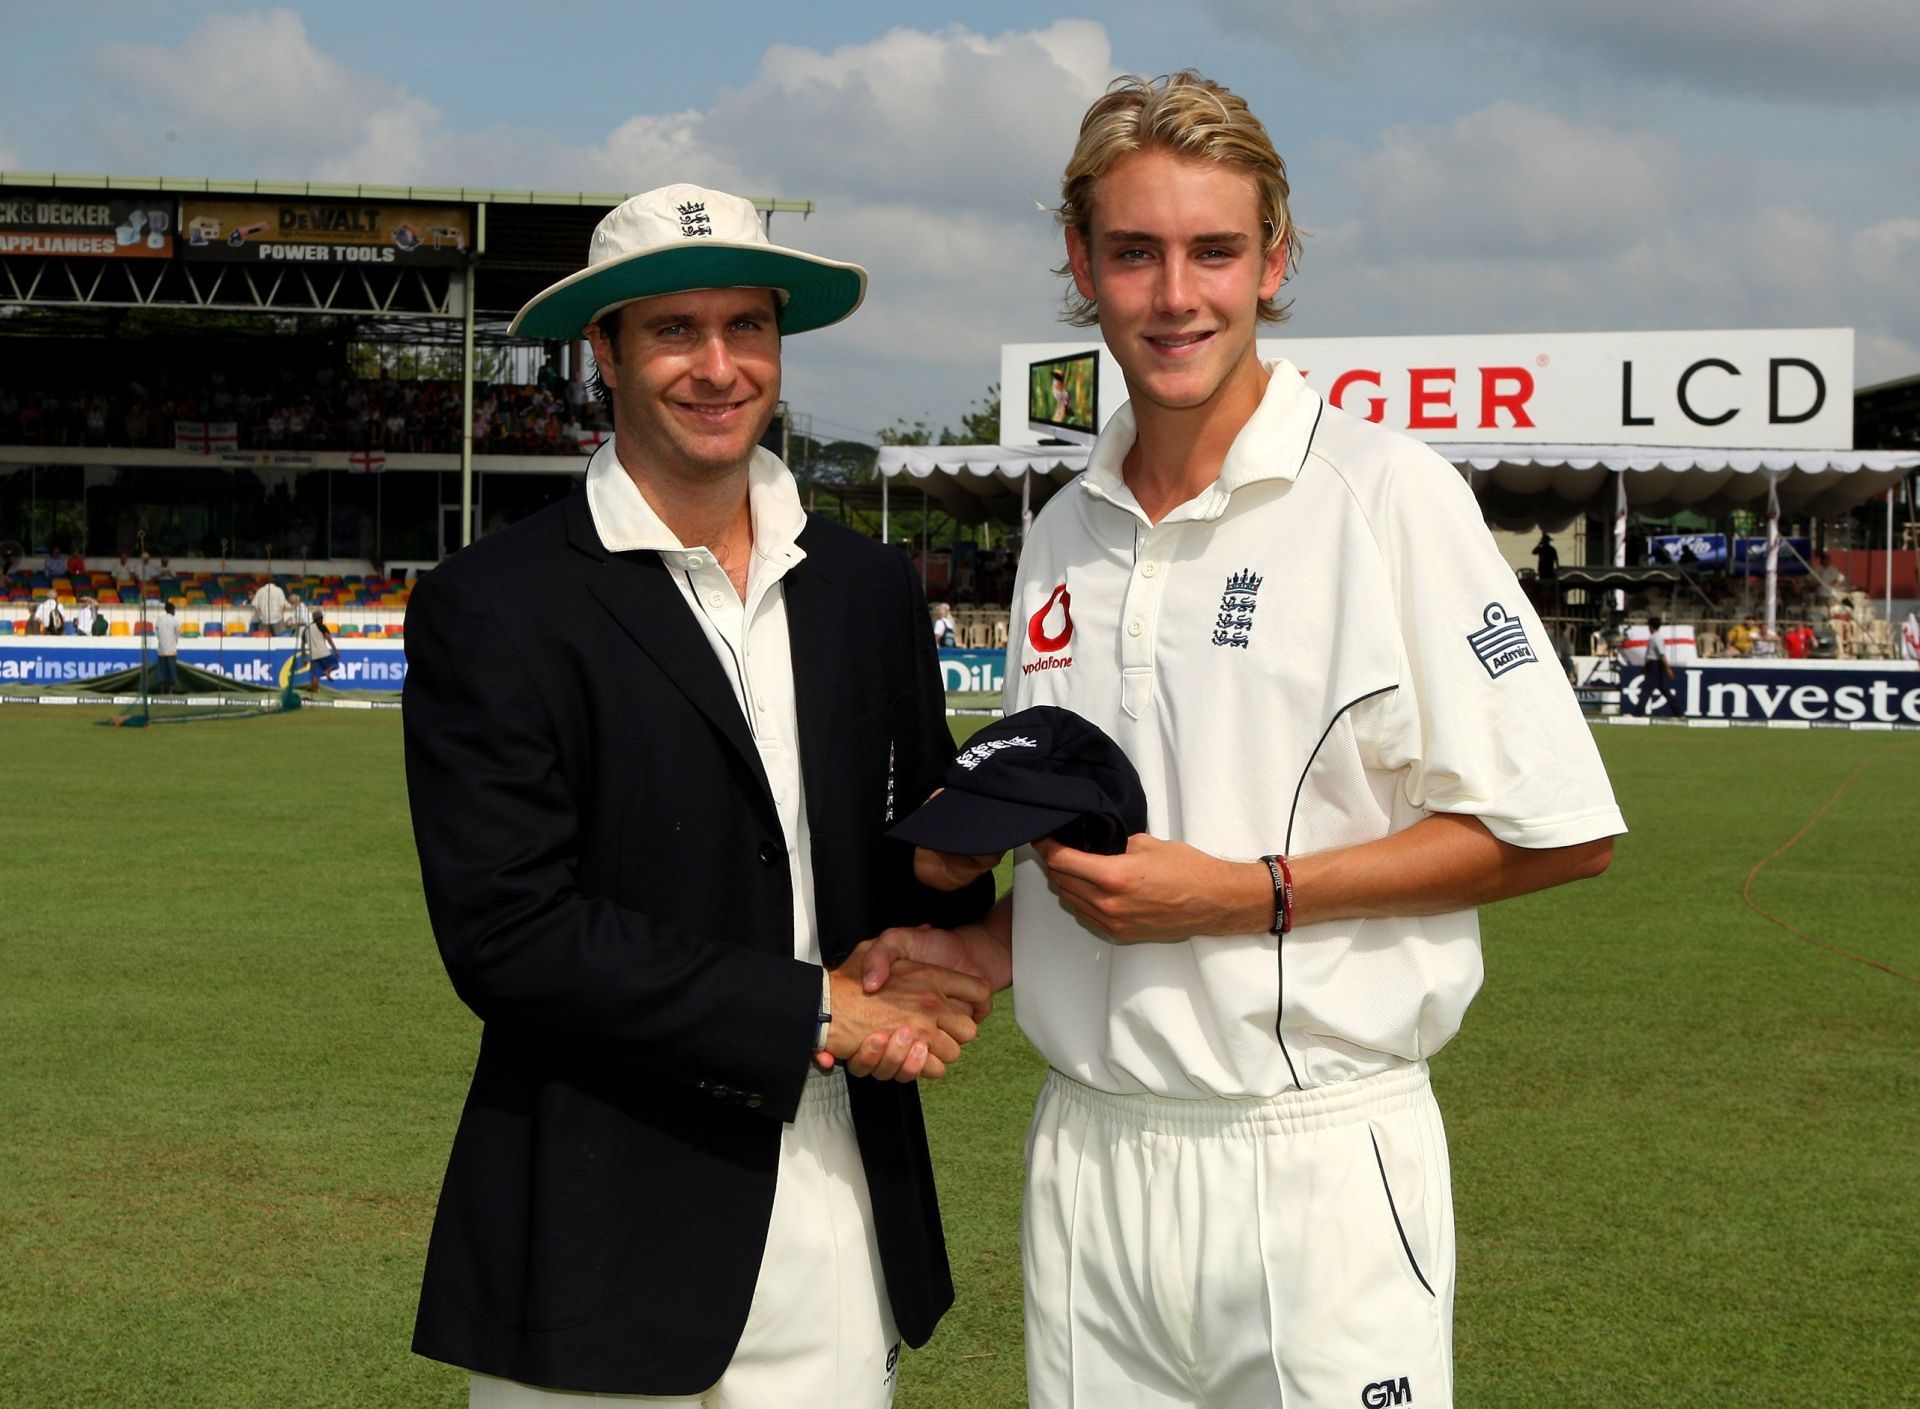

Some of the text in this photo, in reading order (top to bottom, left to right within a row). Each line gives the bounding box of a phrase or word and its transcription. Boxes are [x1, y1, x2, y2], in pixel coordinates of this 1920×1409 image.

[259, 244, 395, 263] POWER TOOLS
[1298, 357, 1827, 429] GER LCD
[1022, 655, 1073, 677] vodafone
[1361, 1376, 1412, 1409] GM
